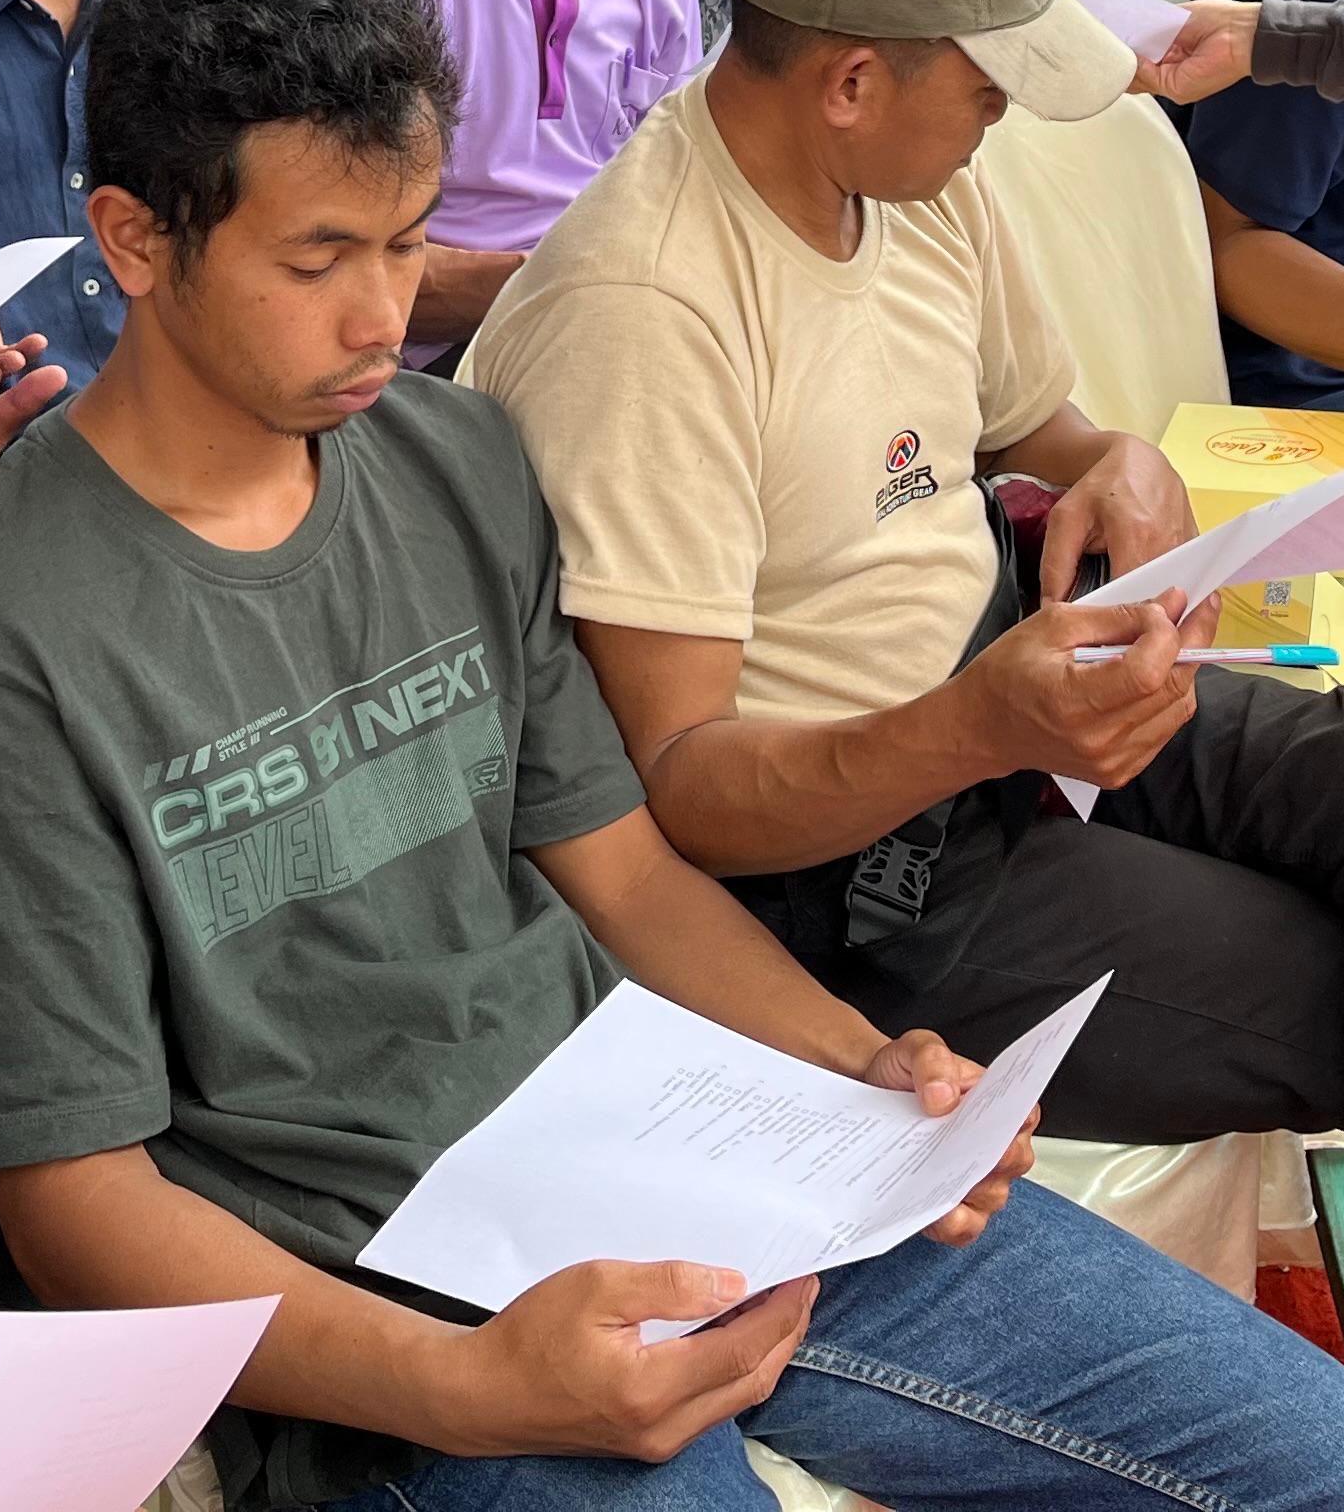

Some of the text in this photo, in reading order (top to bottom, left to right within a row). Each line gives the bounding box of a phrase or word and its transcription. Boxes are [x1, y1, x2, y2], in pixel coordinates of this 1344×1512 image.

[876, 465, 935, 508] EIGER
[912, 485, 935, 498] GEAR
[151, 642, 491, 851] CRS 91 NEXT
[215, 706, 288, 750] CHAMP RUNNING
[218, 741, 248, 762] STYLE
[173, 799, 353, 949] LEVEL
